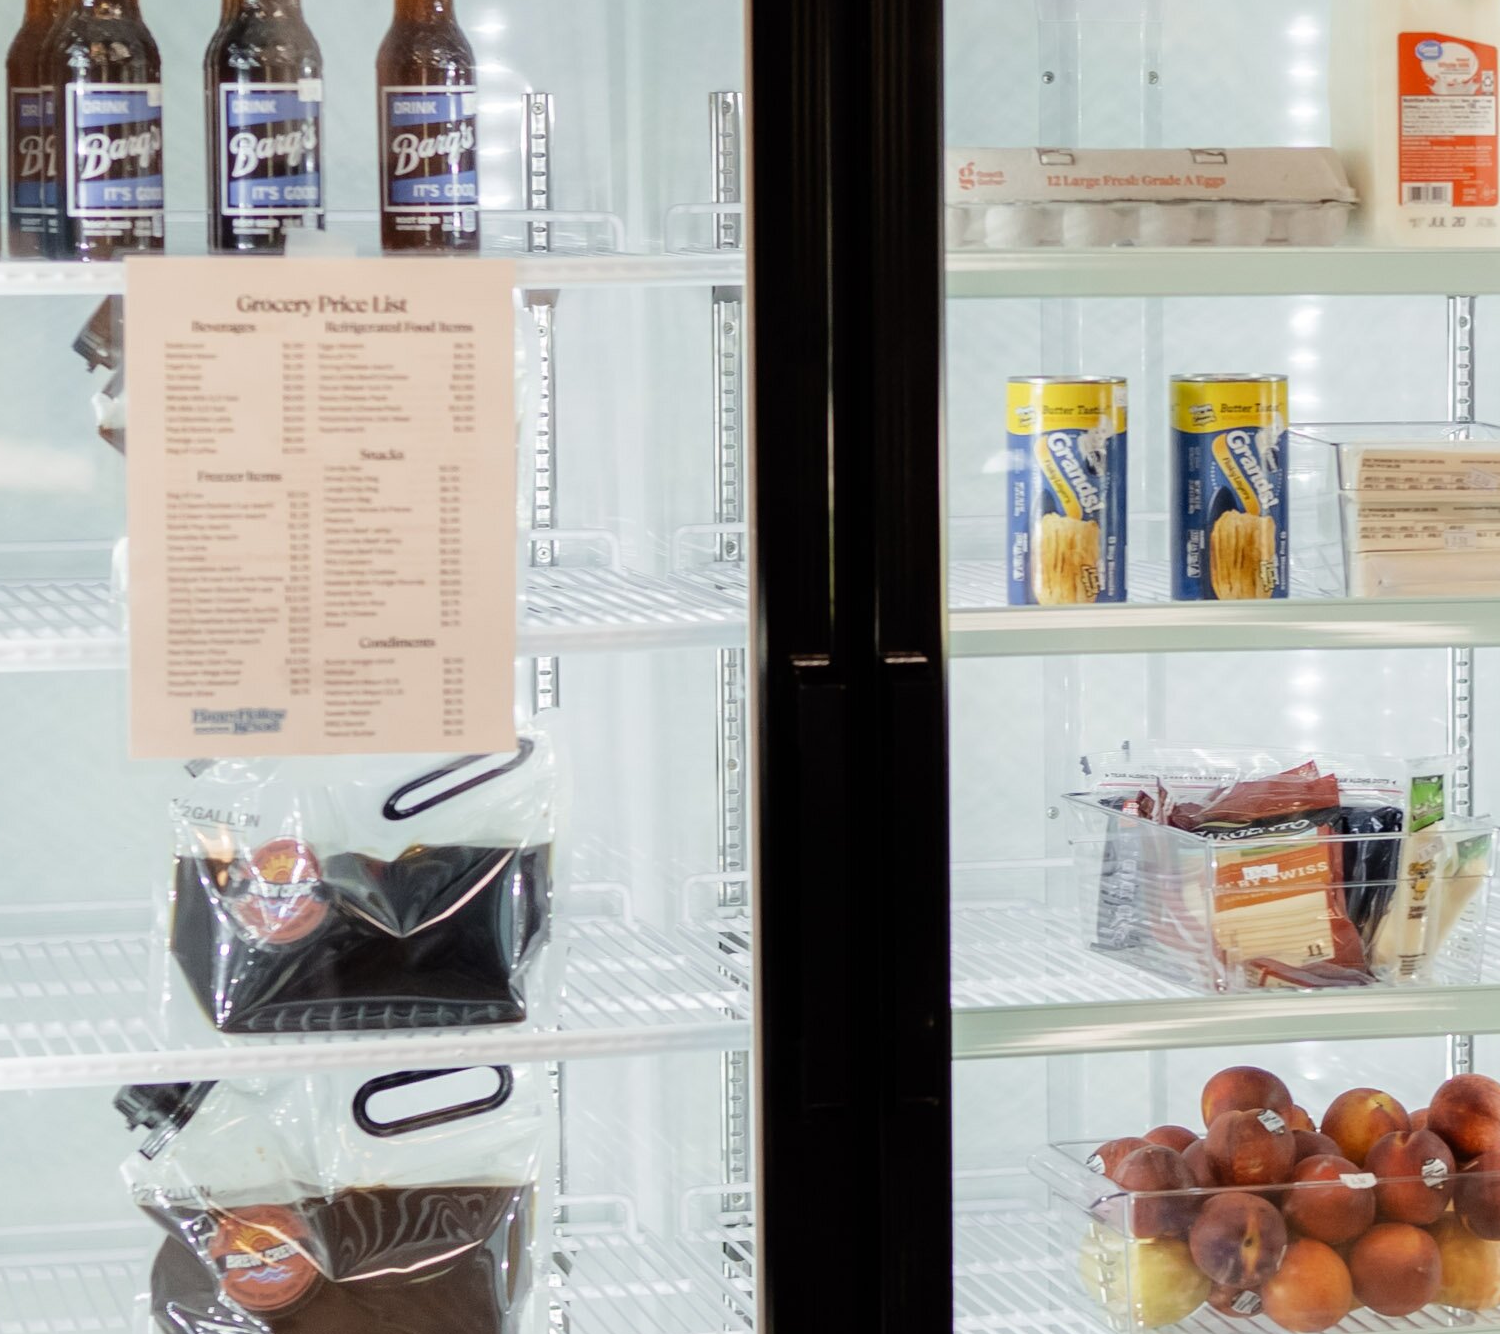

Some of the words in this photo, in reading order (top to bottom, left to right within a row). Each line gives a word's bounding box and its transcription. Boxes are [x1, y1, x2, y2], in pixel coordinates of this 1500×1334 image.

[83, 100, 130, 114] DRINK
[231, 99, 277, 114] DRINK
[393, 100, 438, 114] DRINK
[229, 122, 318, 177] Barq's
[392, 122, 474, 177] Barq's
[1047, 175, 1062, 187] 12
[1063, 175, 1101, 189] Large
[1102, 175, 1140, 187] Fresh
[1141, 175, 1180, 187] Grade
[1183, 175, 1195, 186] A
[1196, 175, 1226, 189] Eggs
[252, 184, 279, 200] IT'S
[412, 183, 440, 198] IT'S
[1429, 217, 1447, 227] JUL
[1451, 216, 1466, 227] 20
[236, 295, 312, 317] Grocery
[318, 295, 368, 313] Price
[372, 295, 408, 313] List
[191, 320, 257, 334] Beverages
[324, 321, 402, 335] Refrigerated
[404, 321, 436, 333] Food
[438, 321, 474, 333] Items
[1220, 403, 1253, 414] Butter
[359, 448, 405, 461] Snacks
[197, 470, 244, 482] Freezer
[246, 471, 282, 482] Items
[1048, 431, 1104, 514] Grands!
[1226, 430, 1280, 511] Grands!
[358, 636, 436, 649] Condiments
[1269, 861, 1329, 883] SWISS
[1307, 944, 1323, 957] 11
